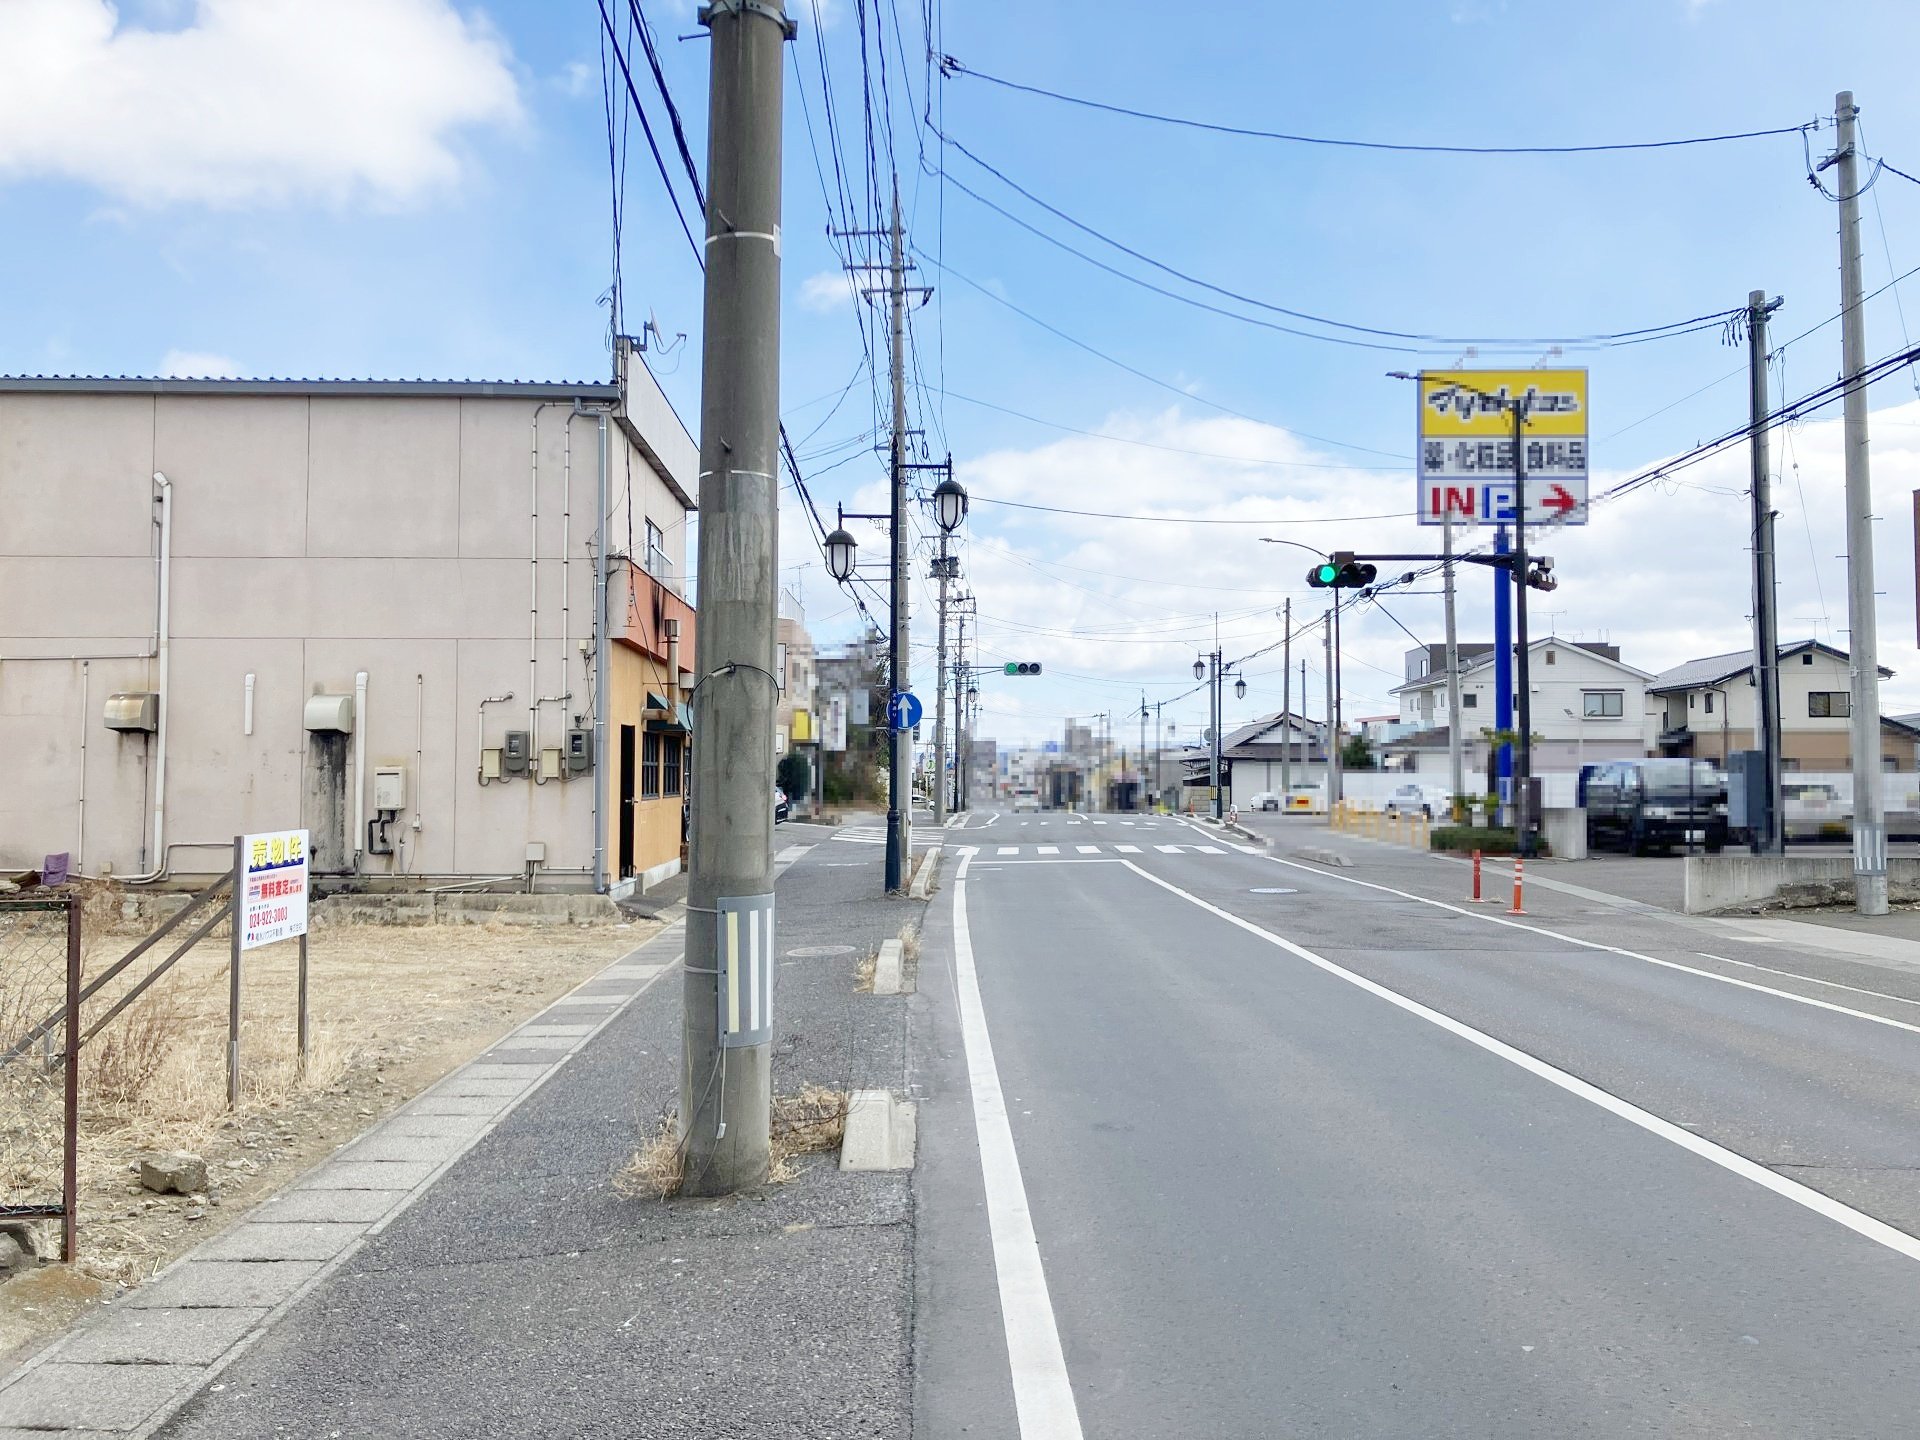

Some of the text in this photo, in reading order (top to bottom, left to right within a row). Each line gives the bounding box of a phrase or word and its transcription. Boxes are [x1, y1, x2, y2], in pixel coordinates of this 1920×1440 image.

[1432, 487, 1474, 518] IN
[253, 836, 302, 867] 売物件
[261, 879, 289, 899] 無料査定
